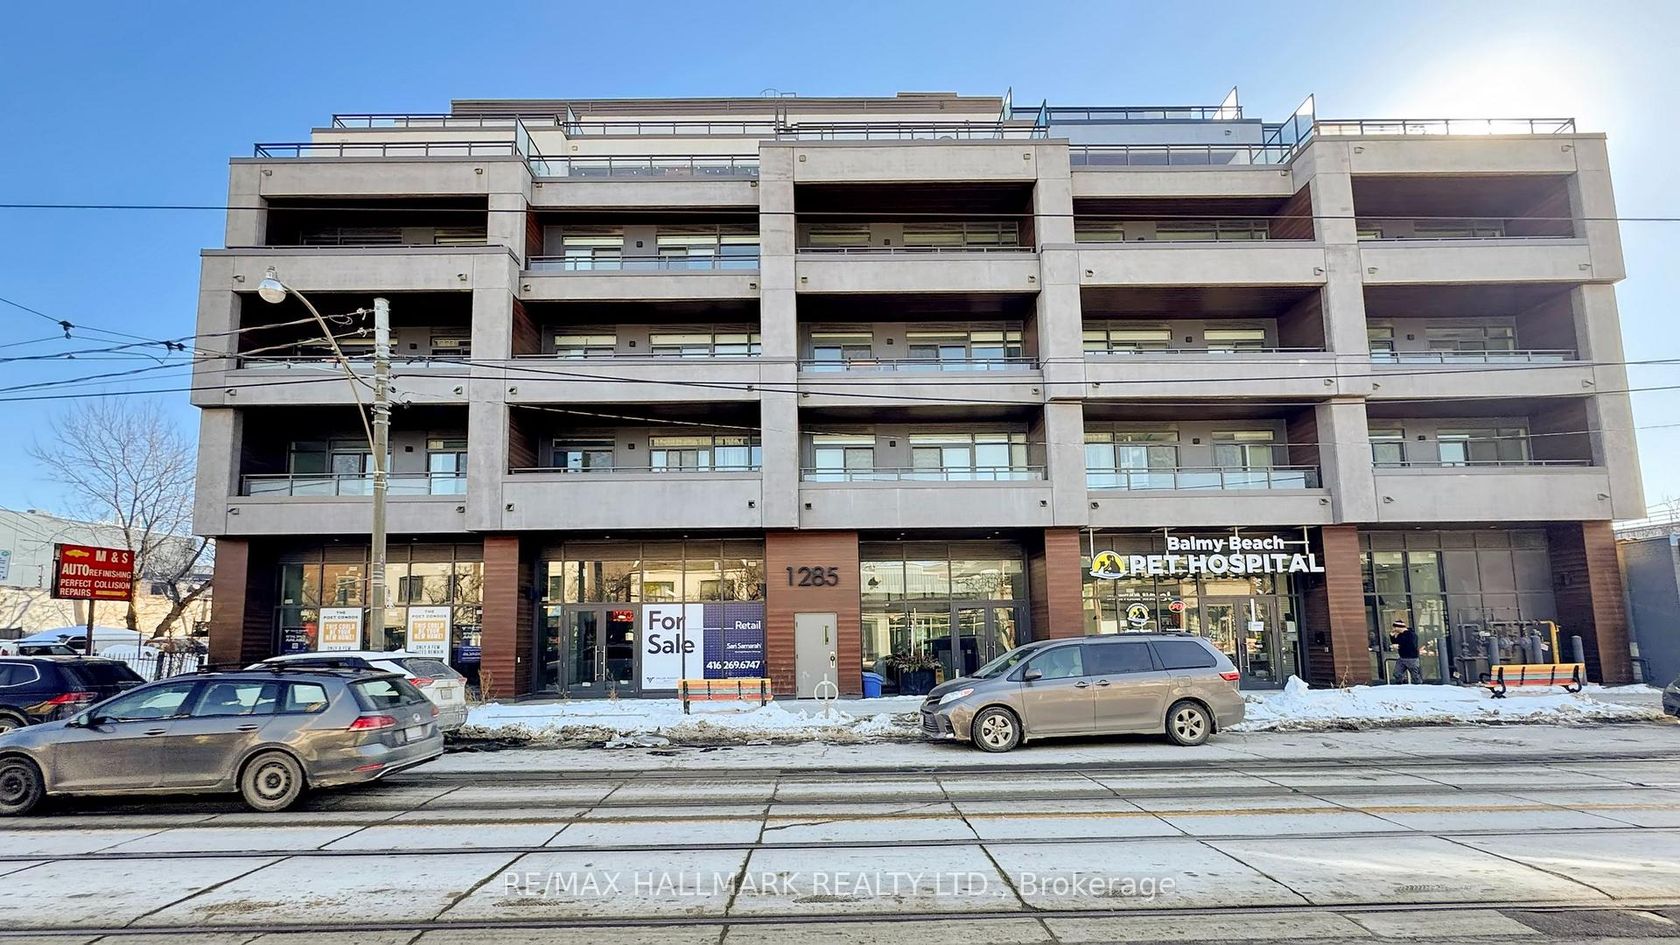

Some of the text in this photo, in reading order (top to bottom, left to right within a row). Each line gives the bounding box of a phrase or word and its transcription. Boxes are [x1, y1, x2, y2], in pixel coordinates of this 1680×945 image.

[1167, 535, 1285, 552] Balmy Beach
[95, 550, 128, 564] M & S
[1129, 553, 1325, 574] PET HOSPITAL
[61, 563, 132, 579] AUTO REFINISHING
[786, 566, 839, 586] 1285
[60, 578, 131, 590] PERFECT COLLISION
[60, 587, 91, 597] REPAIRS
[648, 610, 686, 630] For
[735, 620, 761, 630] Retail
[647, 634, 695, 654] Sale
[706, 660, 760, 670] 416 269.6747
